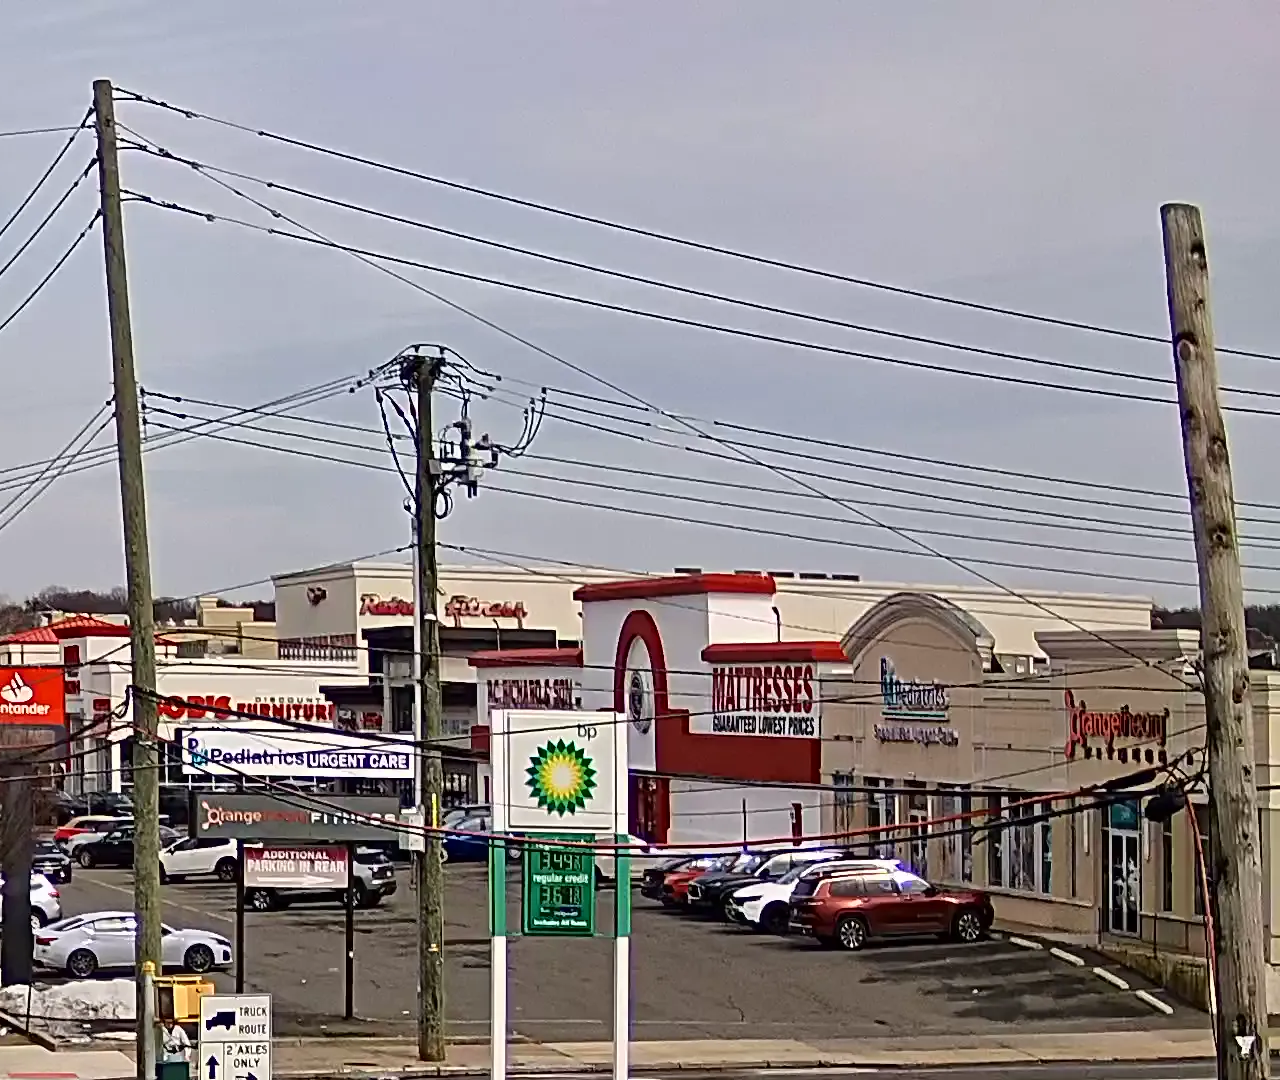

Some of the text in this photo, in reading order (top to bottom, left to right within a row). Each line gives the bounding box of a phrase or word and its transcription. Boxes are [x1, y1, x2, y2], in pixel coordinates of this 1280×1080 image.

[712, 664, 814, 714] MATTRESSES
[157, 695, 232, 719] OB'S
[577, 723, 597, 741] bp
[712, 715, 815, 737] GUARANTEED LOWEST PRICES
[210, 748, 305, 766] Pediatrics
[309, 754, 365, 768] URGENT
[369, 754, 407, 769] CARE
[262, 850, 329, 860] ADDITIONAL
[247, 860, 345, 873] PARKING IN REAR
[533, 873, 588, 885] regular credit
[239, 1006, 268, 1017] TRUCK
[238, 1024, 267, 1035] ROUTE
[226, 1044, 268, 1055] 2 AXLES
[233, 1058, 260, 1069] ONLY
